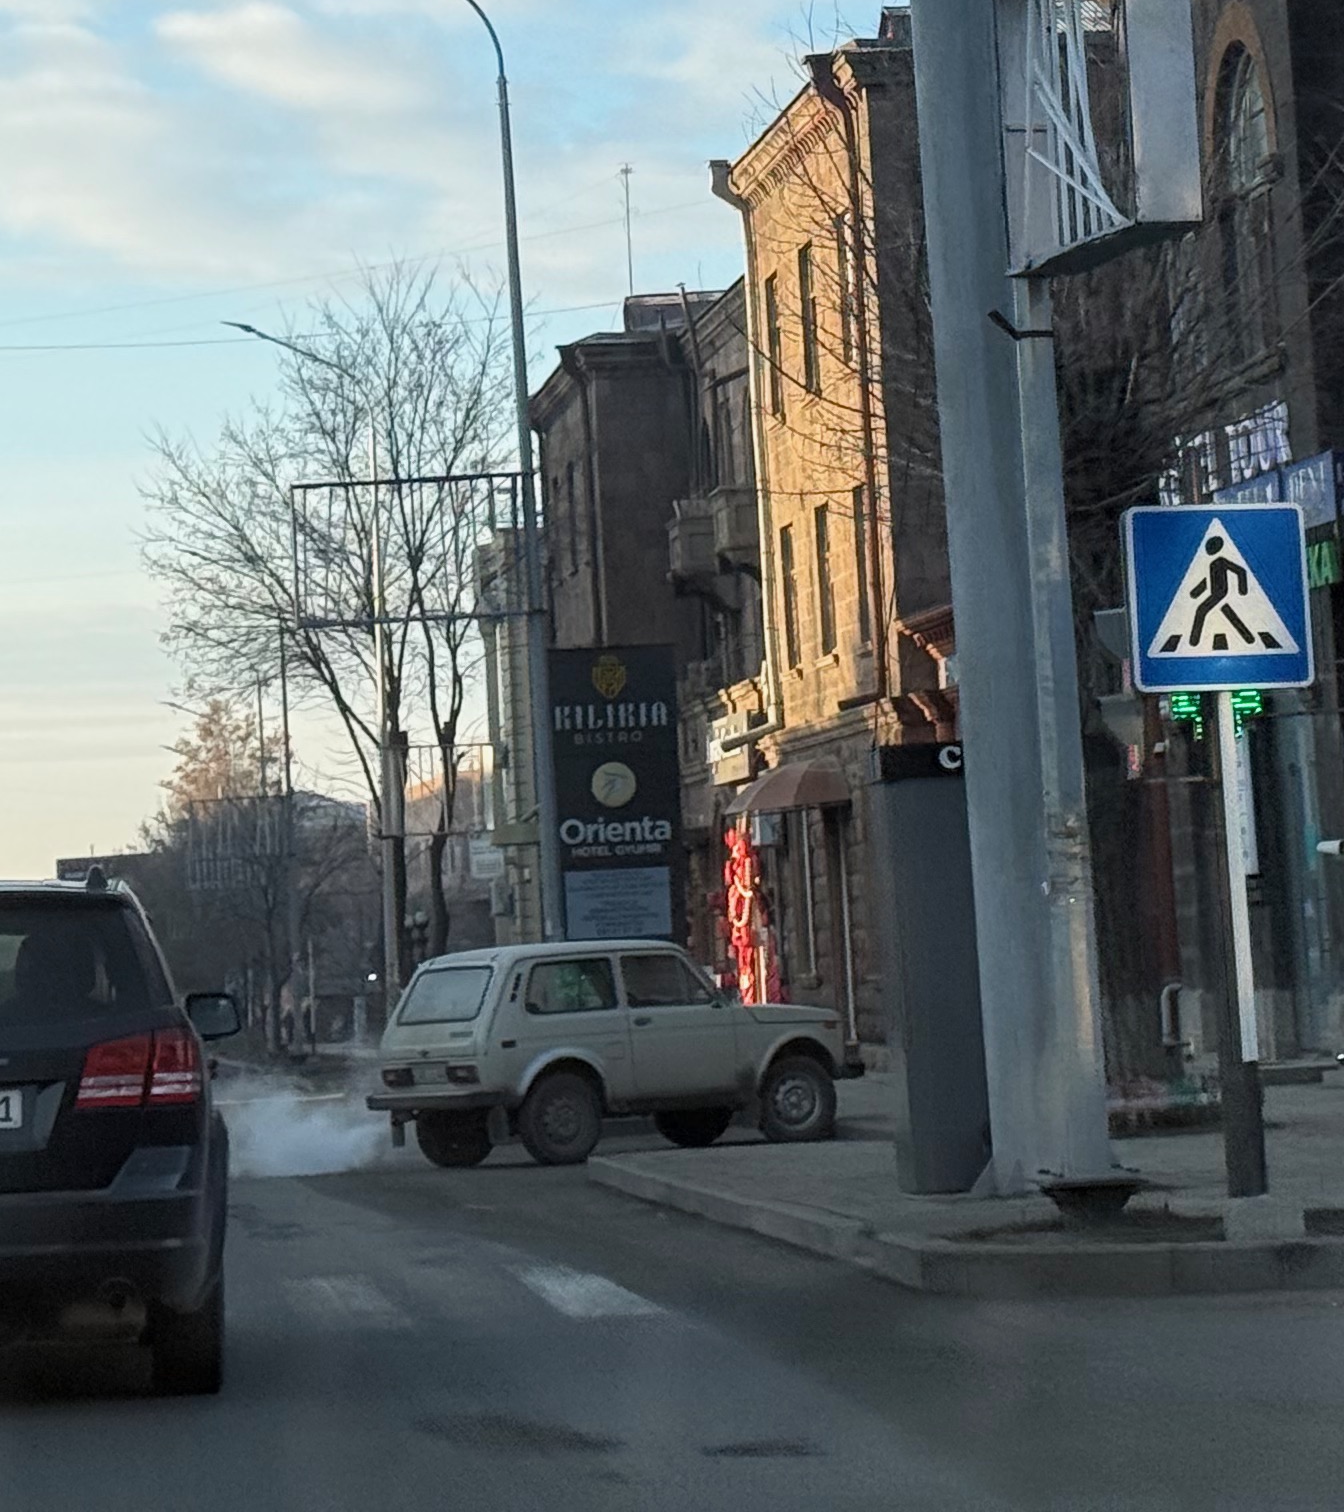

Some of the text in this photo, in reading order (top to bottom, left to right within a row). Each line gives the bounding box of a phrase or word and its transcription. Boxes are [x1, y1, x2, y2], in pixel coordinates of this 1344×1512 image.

[553, 701, 668, 732] KILIKIA
[574, 730, 643, 746] BISTRO
[559, 815, 672, 845] Orienta
[571, 845, 612, 857] HOTEL
